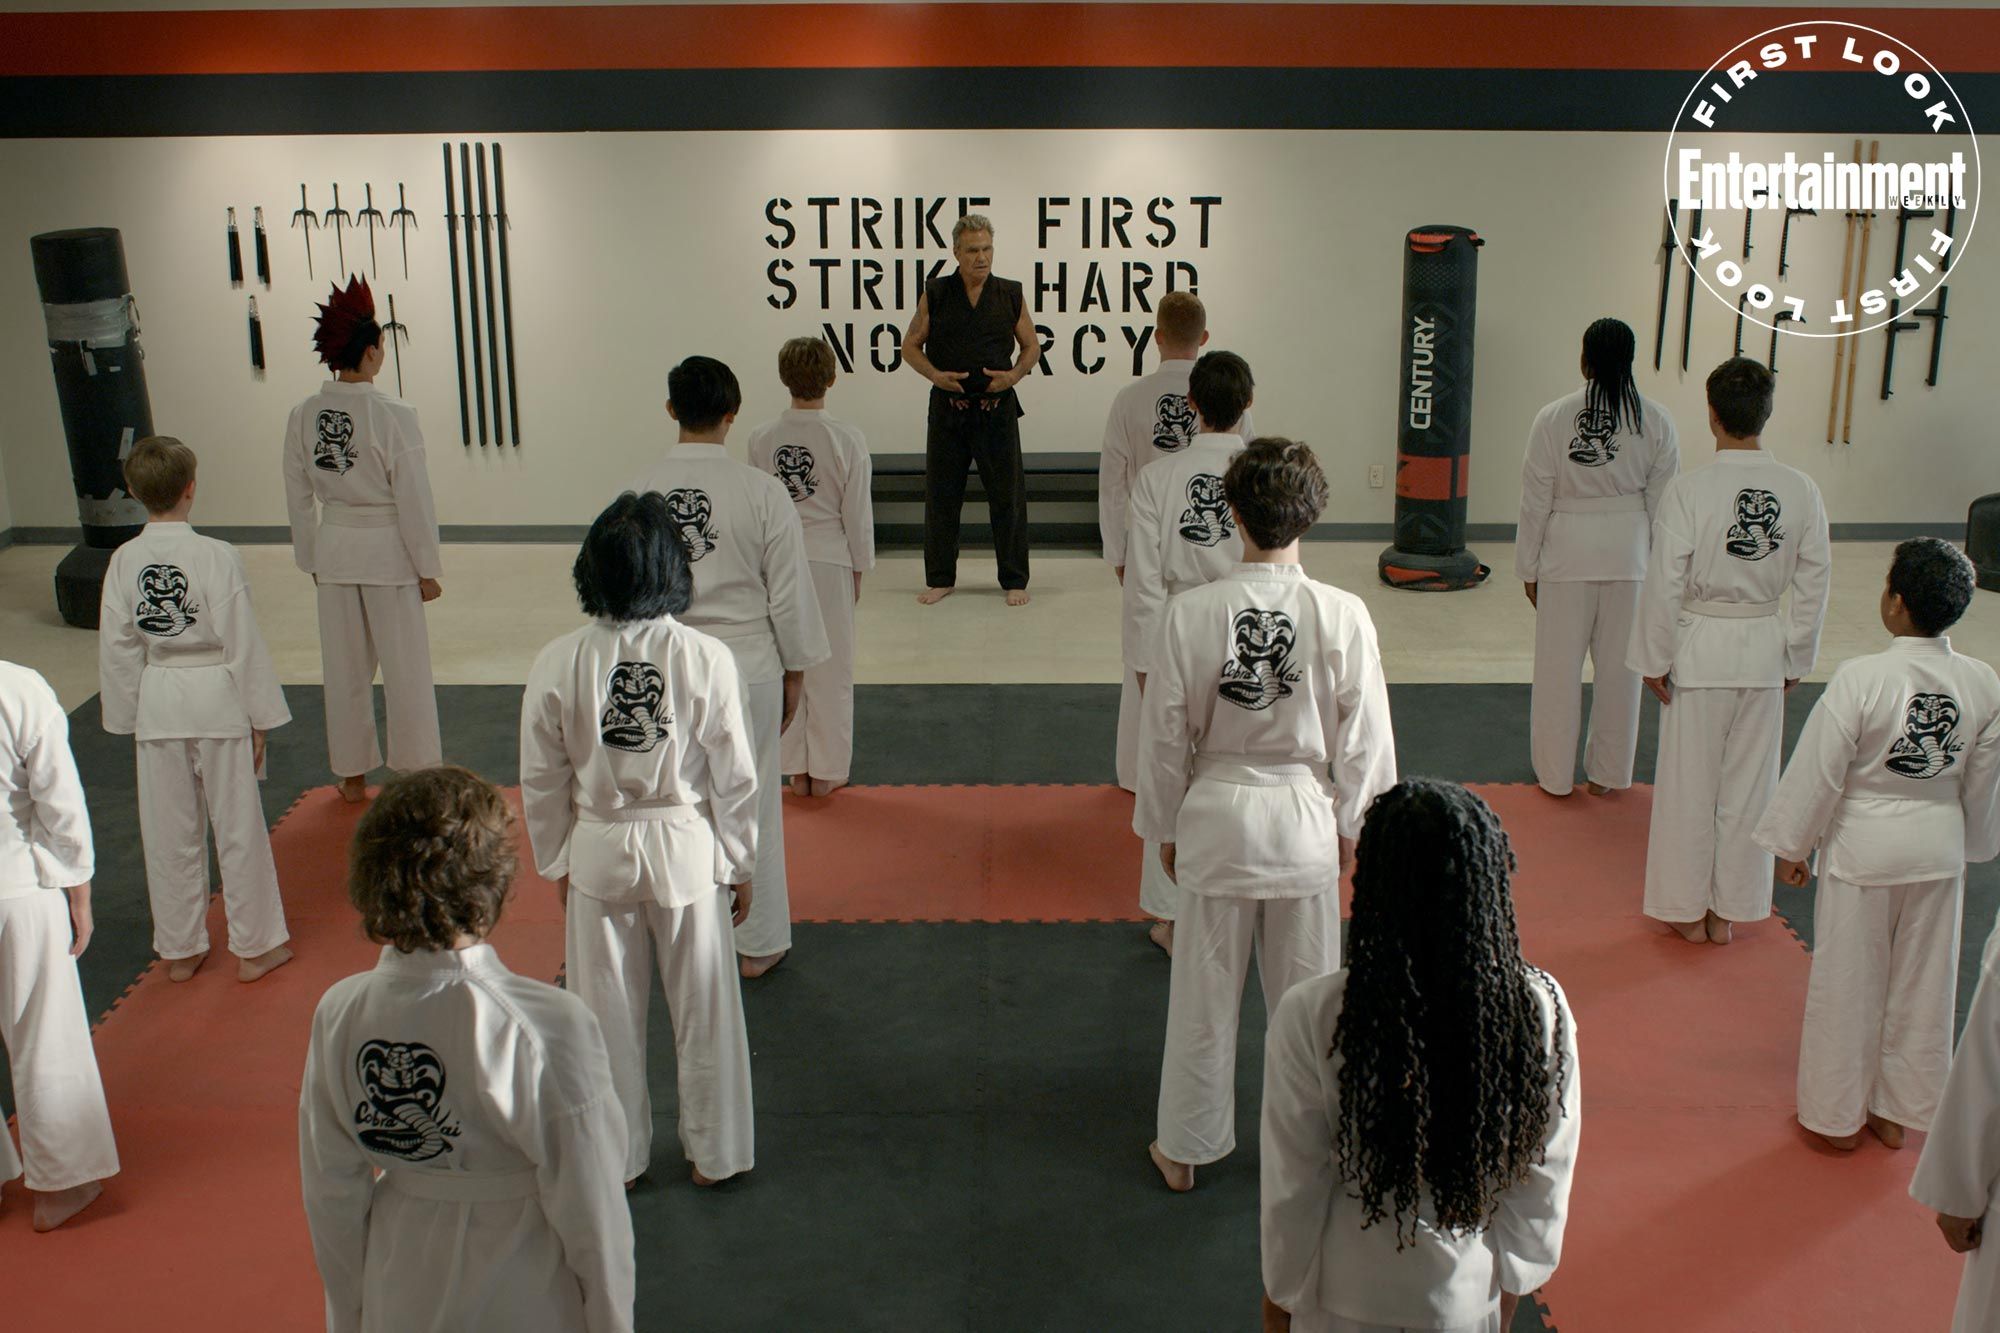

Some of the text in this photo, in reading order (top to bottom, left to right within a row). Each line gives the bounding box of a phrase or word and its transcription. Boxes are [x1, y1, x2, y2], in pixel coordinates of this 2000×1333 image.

[1038, 196, 1222, 250] FIRST
[766, 258, 1198, 313] STRIK HARD
[822, 323, 1154, 377] NO RCY
[355, 1101, 398, 1128] Cobra
